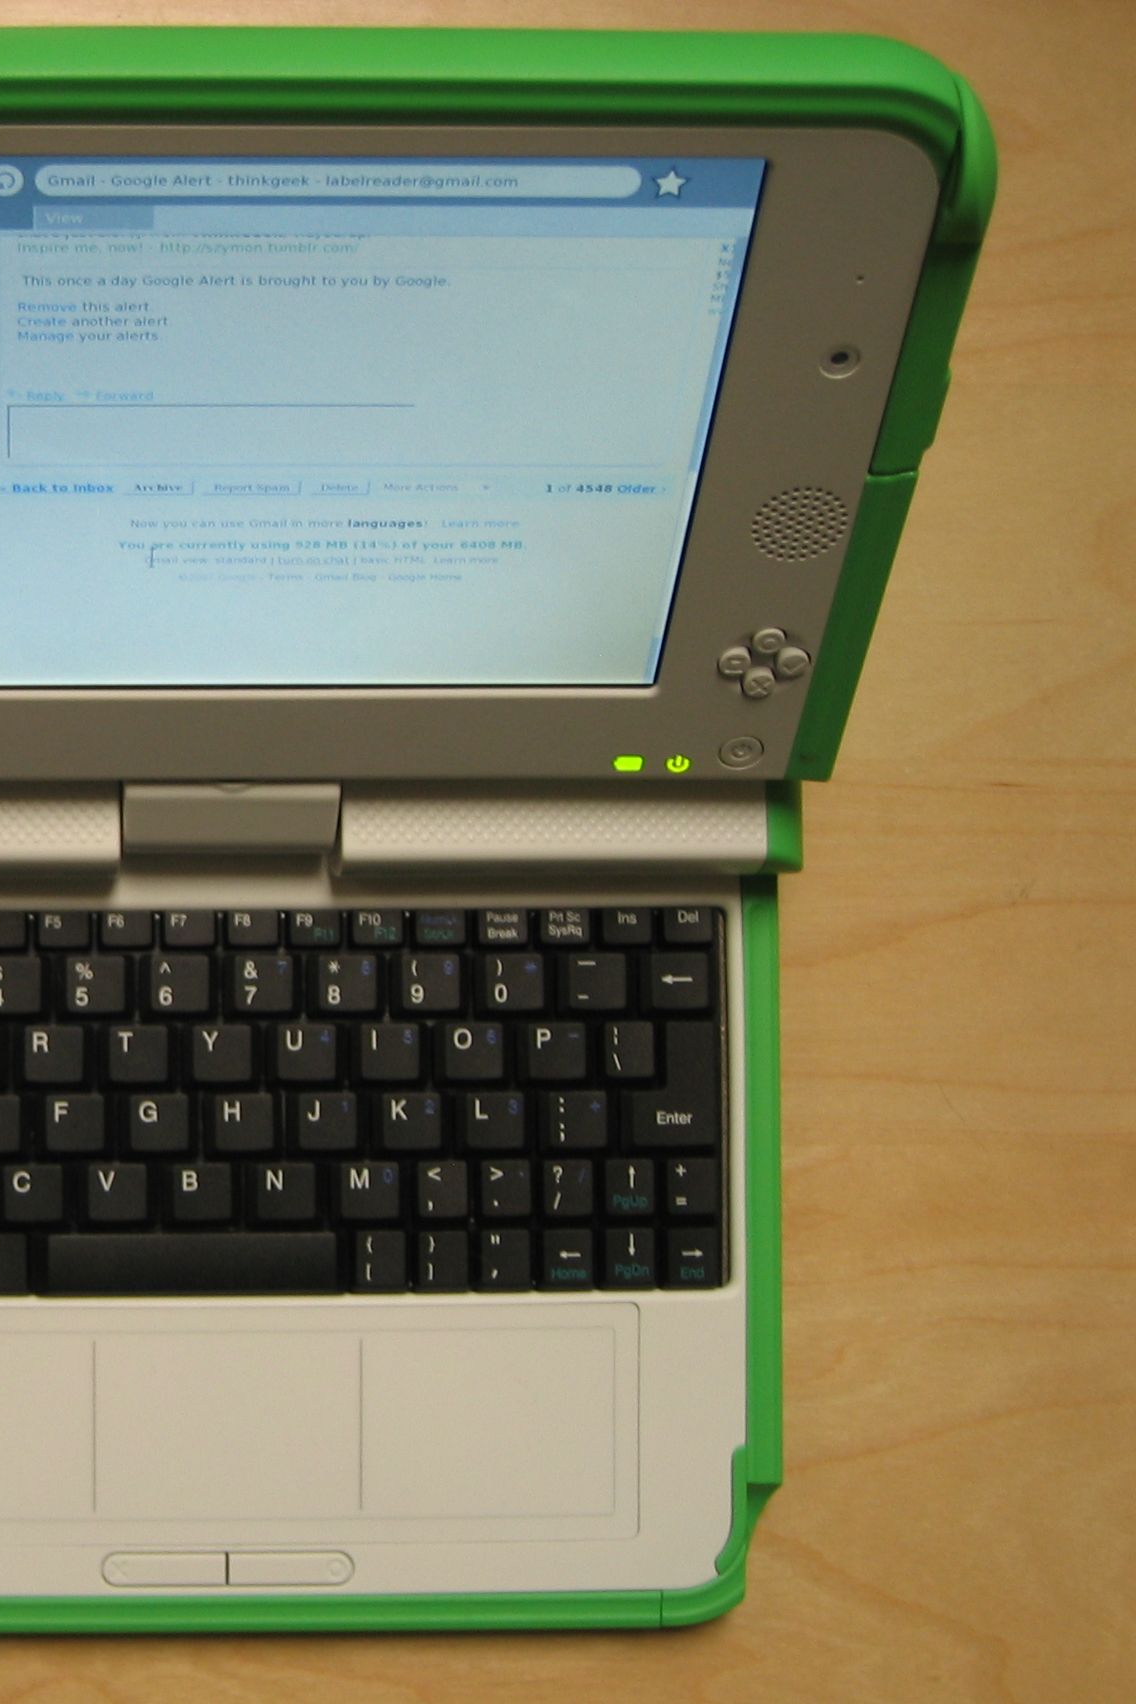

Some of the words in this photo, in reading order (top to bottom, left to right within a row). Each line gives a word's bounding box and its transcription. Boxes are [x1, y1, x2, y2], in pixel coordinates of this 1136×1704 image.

[48, 174, 96, 187] Gmail
[111, 174, 167, 189] Google
[173, 174, 211, 187] Alert
[228, 174, 309, 189] thinkgeek
[325, 174, 518, 189] labelreader@gmail.com
[45, 212, 84, 225] View
[17, 242, 70, 254] Inspire
[22, 275, 52, 286] This
[57, 277, 89, 286] once
[97, 278, 106, 286] a
[112, 275, 137, 288] day
[142, 275, 194, 288] Google
[199, 275, 235, 286] Alert
[241, 275, 253, 286] is
[259, 275, 315, 288] brought
[322, 276, 335, 286] to
[341, 278, 368, 288] you
[373, 275, 391, 289] by
[395, 275, 451, 288] Google.
[17, 302, 77, 312] Remove
[82, 302, 110, 312] this
[17, 316, 67, 327] Create
[72, 316, 128, 327] another
[17, 331, 75, 343] Manage
[79, 333, 111, 343] your
[96, 391, 154, 401] Forward
[12, 484, 49, 493] Back
[52, 484, 68, 493] to
[73, 484, 114, 493] Inbox
[134, 483, 182, 492] Archive
[214, 483, 252, 494] Report
[321, 483, 358, 492] Delete
[383, 483, 411, 491] More
[415, 483, 459, 491] Actions
[576, 484, 612, 493] 4548
[617, 484, 656, 494] Older
[130, 519, 158, 528] Now
[163, 520, 188, 530] you
[192, 520, 216, 528] can
[220, 520, 244, 528] use
[249, 519, 287, 528] Gmail
[291, 519, 303, 528] in
[308, 520, 343, 528] more
[442, 519, 479, 528] Learn
[485, 520, 520, 528] more
[119, 541, 145, 550] You
[179, 540, 245, 551] currently
[250, 541, 290, 551] using
[326, 541, 348, 549] MB
[402, 541, 418, 549] of
[422, 541, 454, 551] your
[45, 915, 63, 929] F5
[107, 914, 125, 928] F6
[170, 914, 188, 927] F7
[233, 914, 252, 928] F8
[296, 913, 314, 928] F9
[358, 912, 382, 927] F10
[487, 912, 519, 924] Pause
[567, 911, 580, 923] Sc
[617, 912, 637, 925] Ins
[677, 911, 699, 924] Del
[313, 926, 334, 941] F11
[487, 928, 519, 939] Break
[548, 924, 583, 938] SysRq
[75, 986, 90, 1006] 5
[159, 986, 174, 1006] 6
[244, 985, 258, 1005] 7
[327, 984, 342, 1005] 8
[409, 984, 424, 1004] 9
[494, 983, 508, 1003] 0
[32, 1031, 50, 1054] R
[117, 1031, 134, 1054] T
[202, 1030, 220, 1053] Y
[285, 1028, 303, 1051] U
[371, 1028, 378, 1051] I
[453, 1027, 473, 1050] O
[536, 1027, 552, 1050] P
[54, 1101, 69, 1123] F
[139, 1101, 159, 1123] G
[224, 1100, 242, 1123] H
[306, 1099, 321, 1122] J
[390, 1099, 409, 1121] K
[475, 1097, 490, 1120] L
[656, 1109, 694, 1125] Enter
[12, 1170, 32, 1193] C
[98, 1170, 116, 1193] V
[181, 1170, 200, 1192] B
[266, 1169, 284, 1192] N
[349, 1167, 370, 1191] M
[612, 1194, 648, 1211] PgUp
[550, 1267, 588, 1281] Home
[614, 1263, 650, 1279] PgDn
[680, 1266, 705, 1279] End
